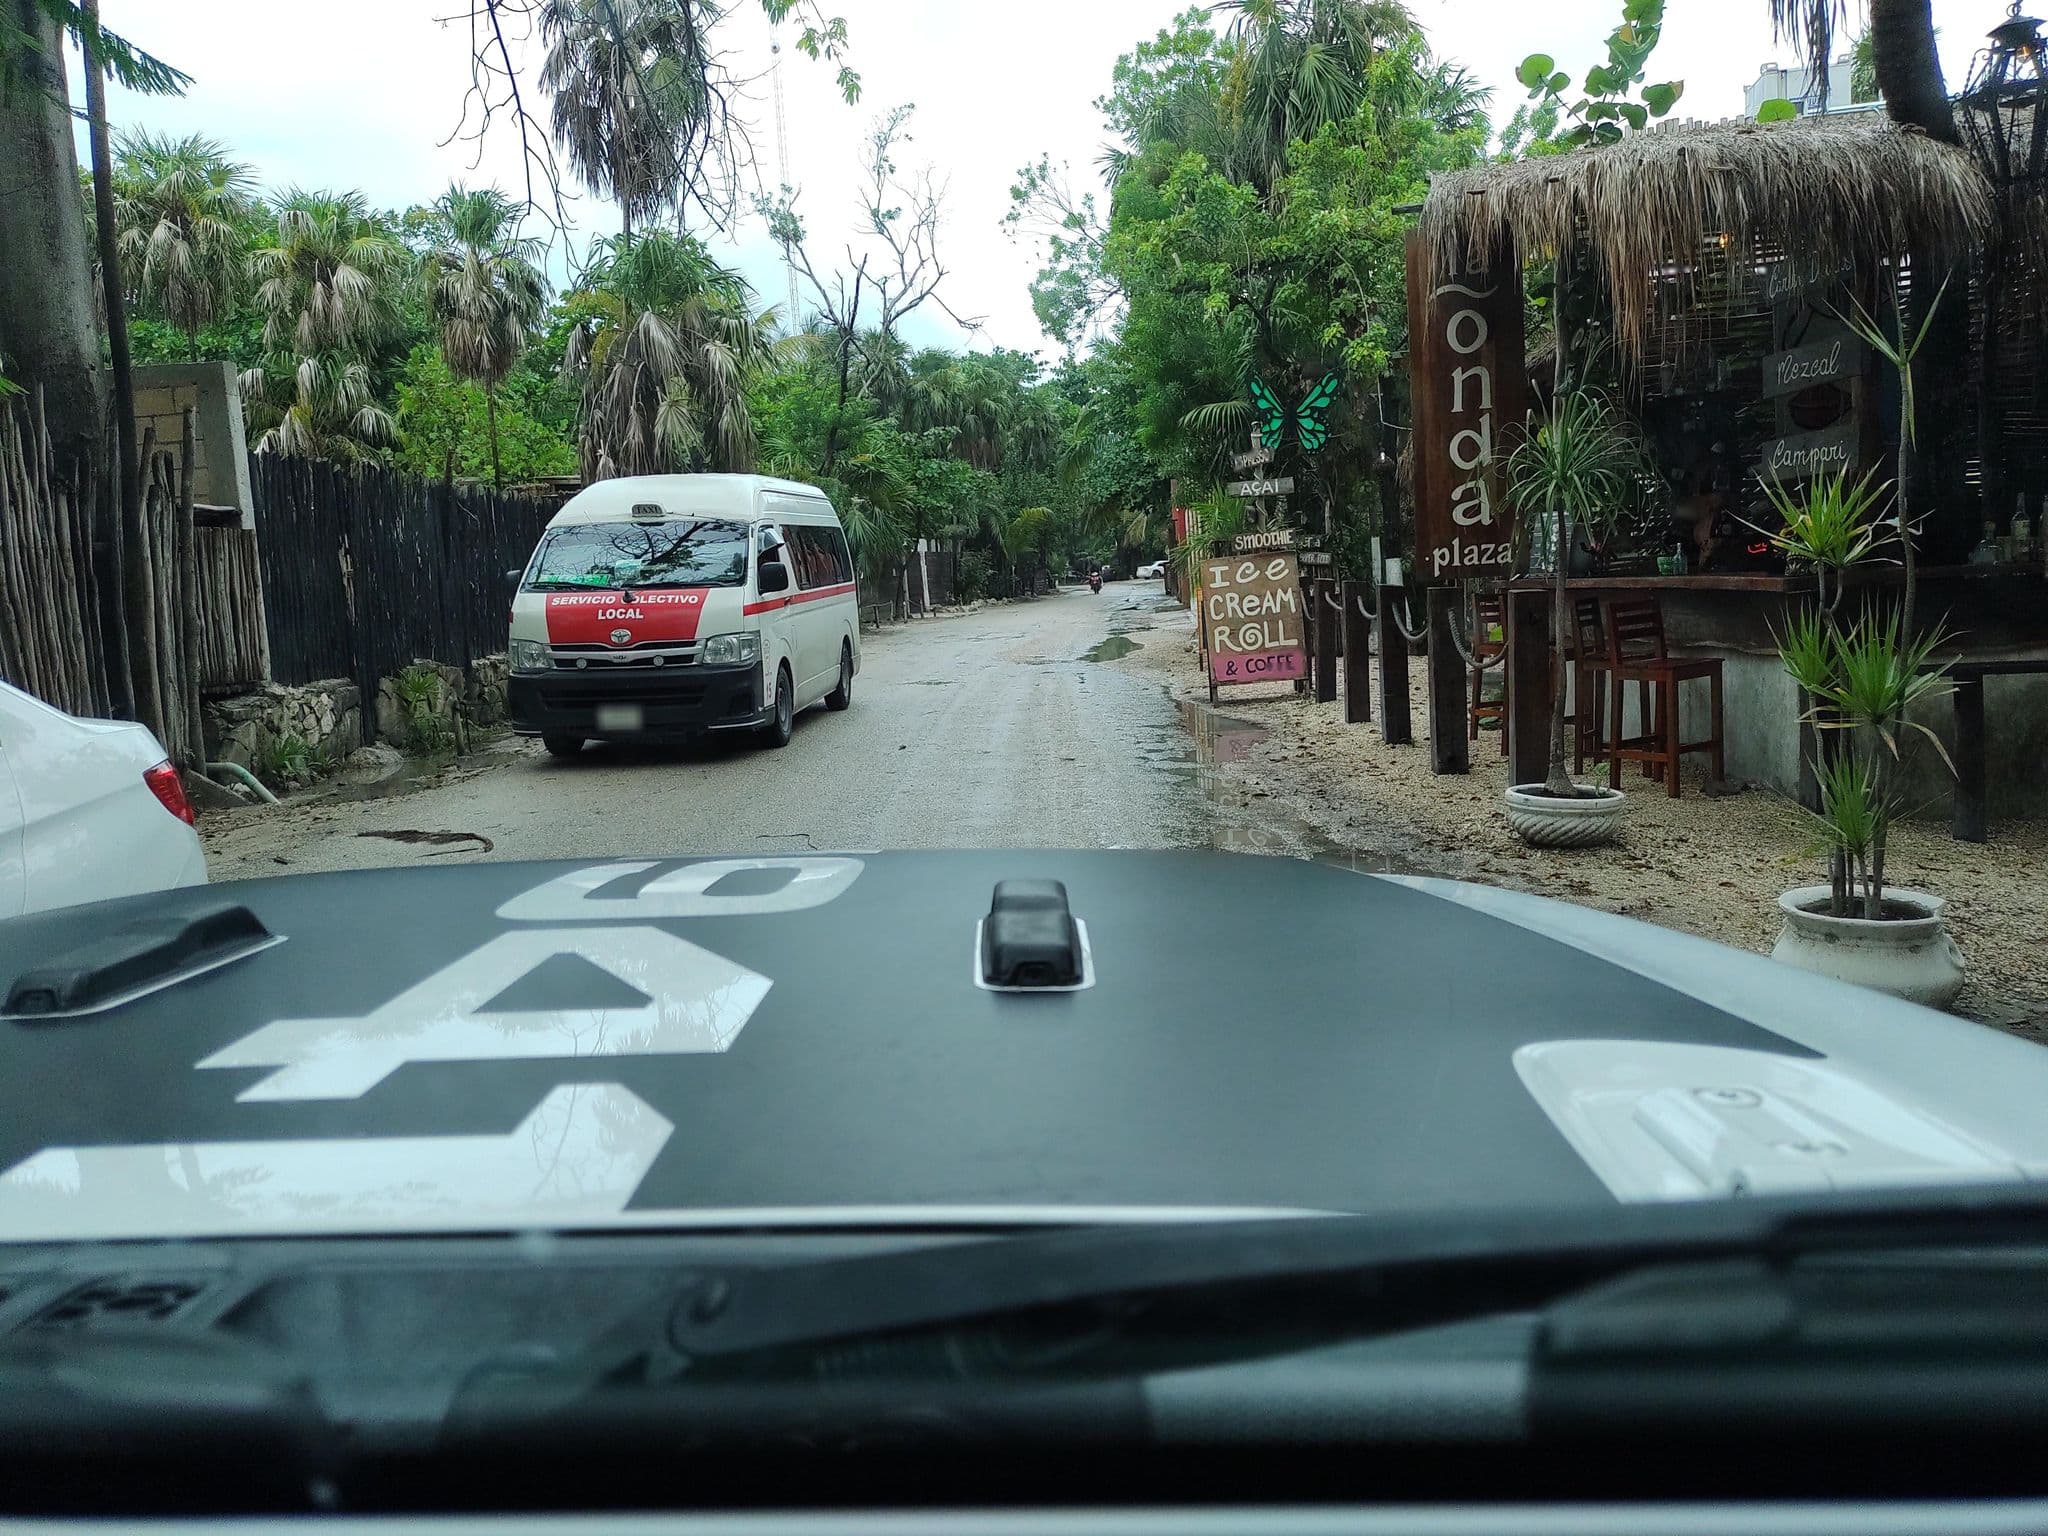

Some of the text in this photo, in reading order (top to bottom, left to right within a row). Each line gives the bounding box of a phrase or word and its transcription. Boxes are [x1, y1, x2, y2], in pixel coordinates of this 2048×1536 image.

[1777, 340, 1841, 385] Mezcal
[1444, 308, 1495, 528] onda
[1772, 439, 1847, 472] Campari
[636, 505, 662, 514] TAXI
[1234, 530, 1294, 551] SMOOTHIE
[1433, 536, 1514, 577] plaza
[551, 595, 617, 606] SERVICIO
[597, 609, 644, 620] LOCAL
[1214, 620, 1299, 654] ROLL
[1225, 654, 1295, 676] & COFFE
